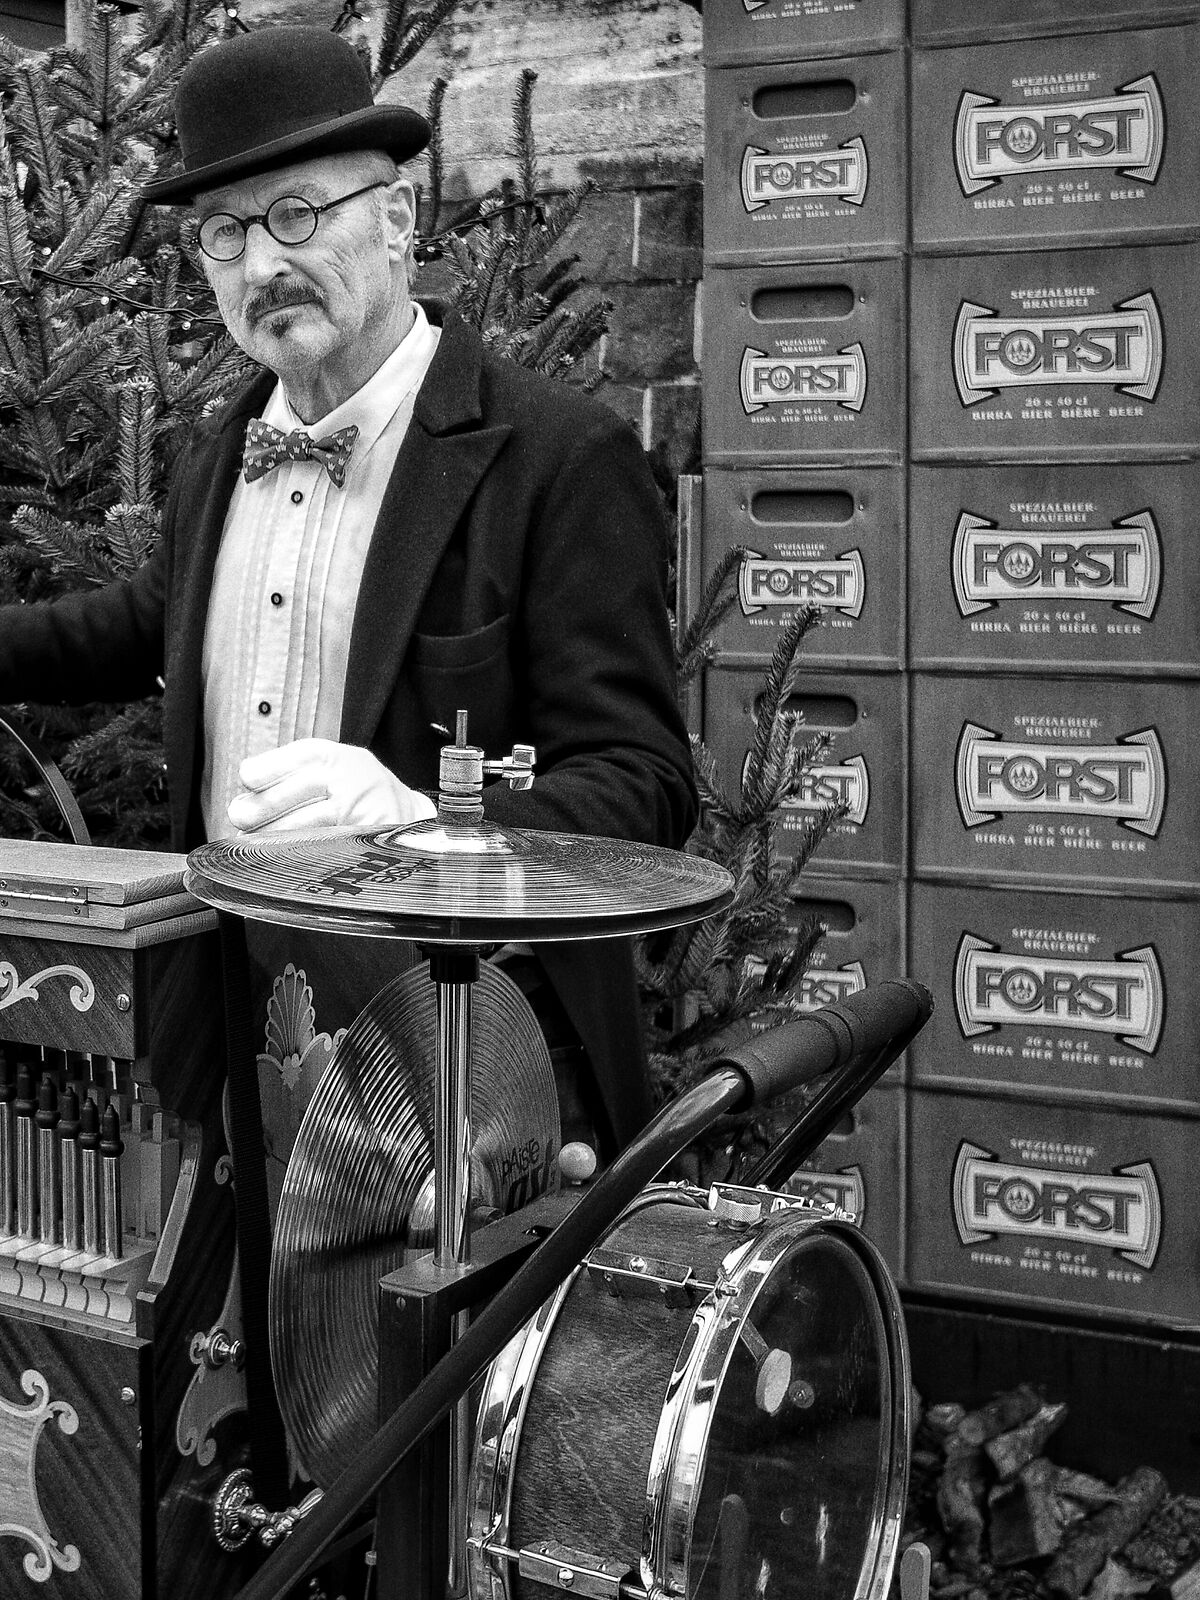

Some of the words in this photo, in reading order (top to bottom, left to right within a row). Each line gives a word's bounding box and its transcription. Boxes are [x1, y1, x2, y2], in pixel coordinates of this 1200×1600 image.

[976, 109, 1143, 164] FORST
[755, 158, 856, 192] FORST
[1011, 287, 1100, 300] SPEZIALBIER-
[1022, 297, 1089, 309] BRAUEREI
[975, 326, 1142, 375] FORST
[753, 365, 854, 394] FORST
[972, 411, 1012, 421] BIRRA
[1022, 410, 1052, 419] BIER
[1108, 407, 1143, 417] BEER
[1009, 502, 1097, 513] SPEZIALBIER-
[1021, 513, 1086, 523] BRAUEREI
[974, 543, 1140, 588] FORST
[751, 569, 853, 598] FORST
[971, 622, 1011, 632] BIRRA
[1020, 622, 1051, 633] BIER
[1107, 624, 1142, 634] BEER
[1025, 727, 1091, 738] BRAUEREI
[978, 755, 1145, 804] FORST
[976, 967, 1143, 1019] FORST
[974, 1174, 1140, 1234] FORST
